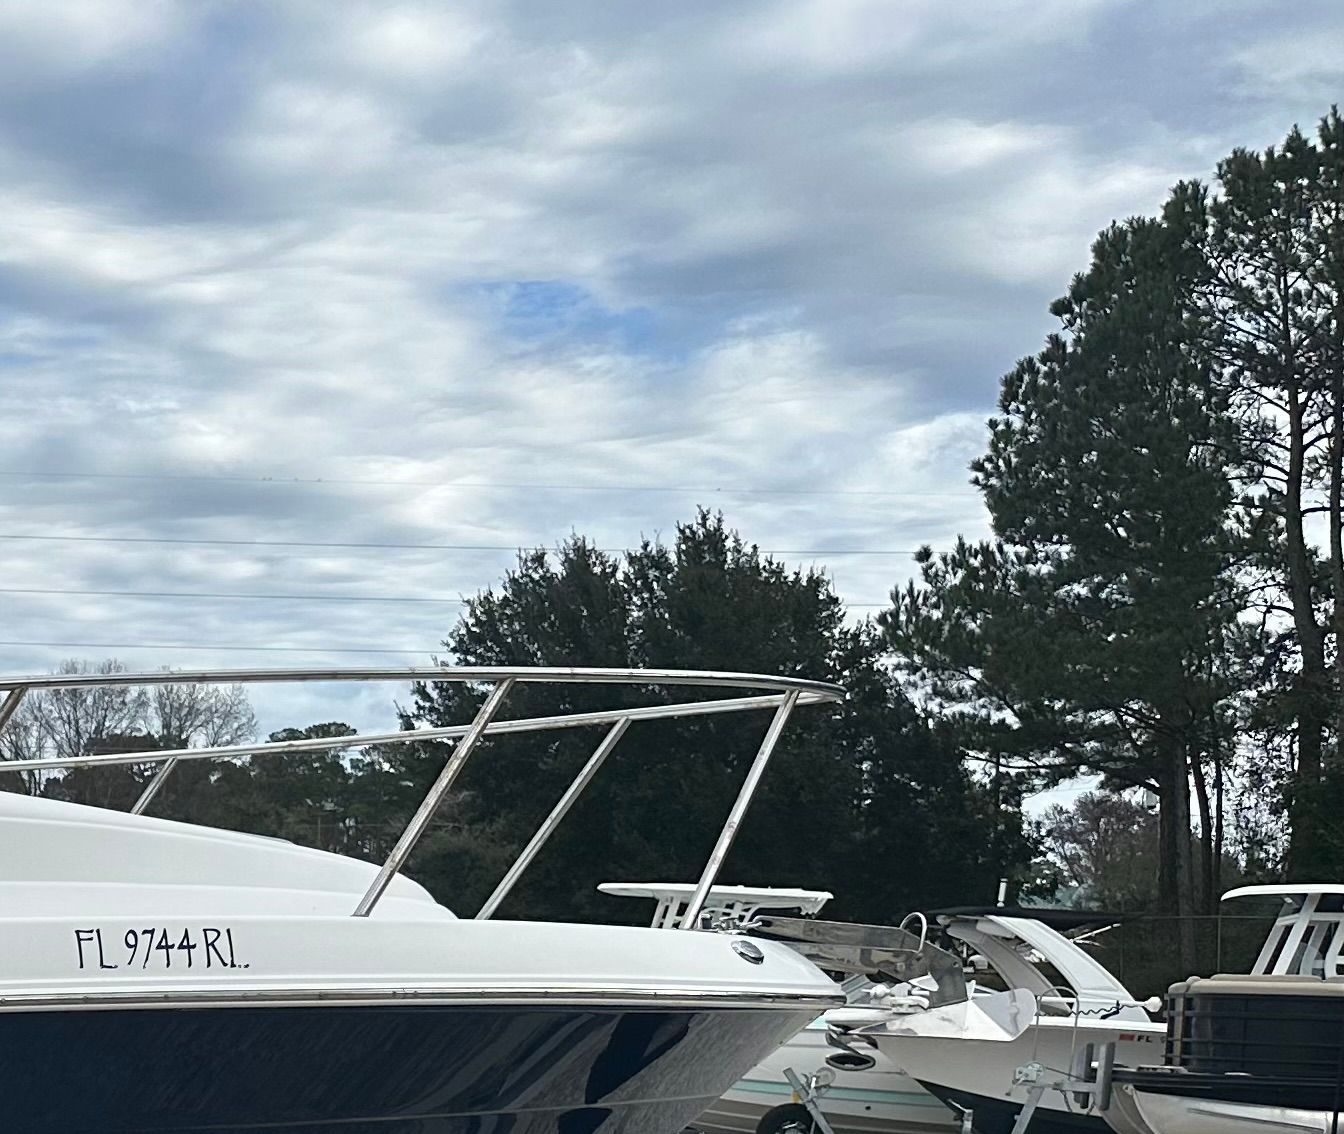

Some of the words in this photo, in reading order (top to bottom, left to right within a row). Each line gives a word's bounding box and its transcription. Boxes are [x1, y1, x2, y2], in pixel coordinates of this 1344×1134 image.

[75, 928, 118, 969] FL
[124, 927, 197, 969] 9744
[1137, 1035, 1152, 1043] FL
